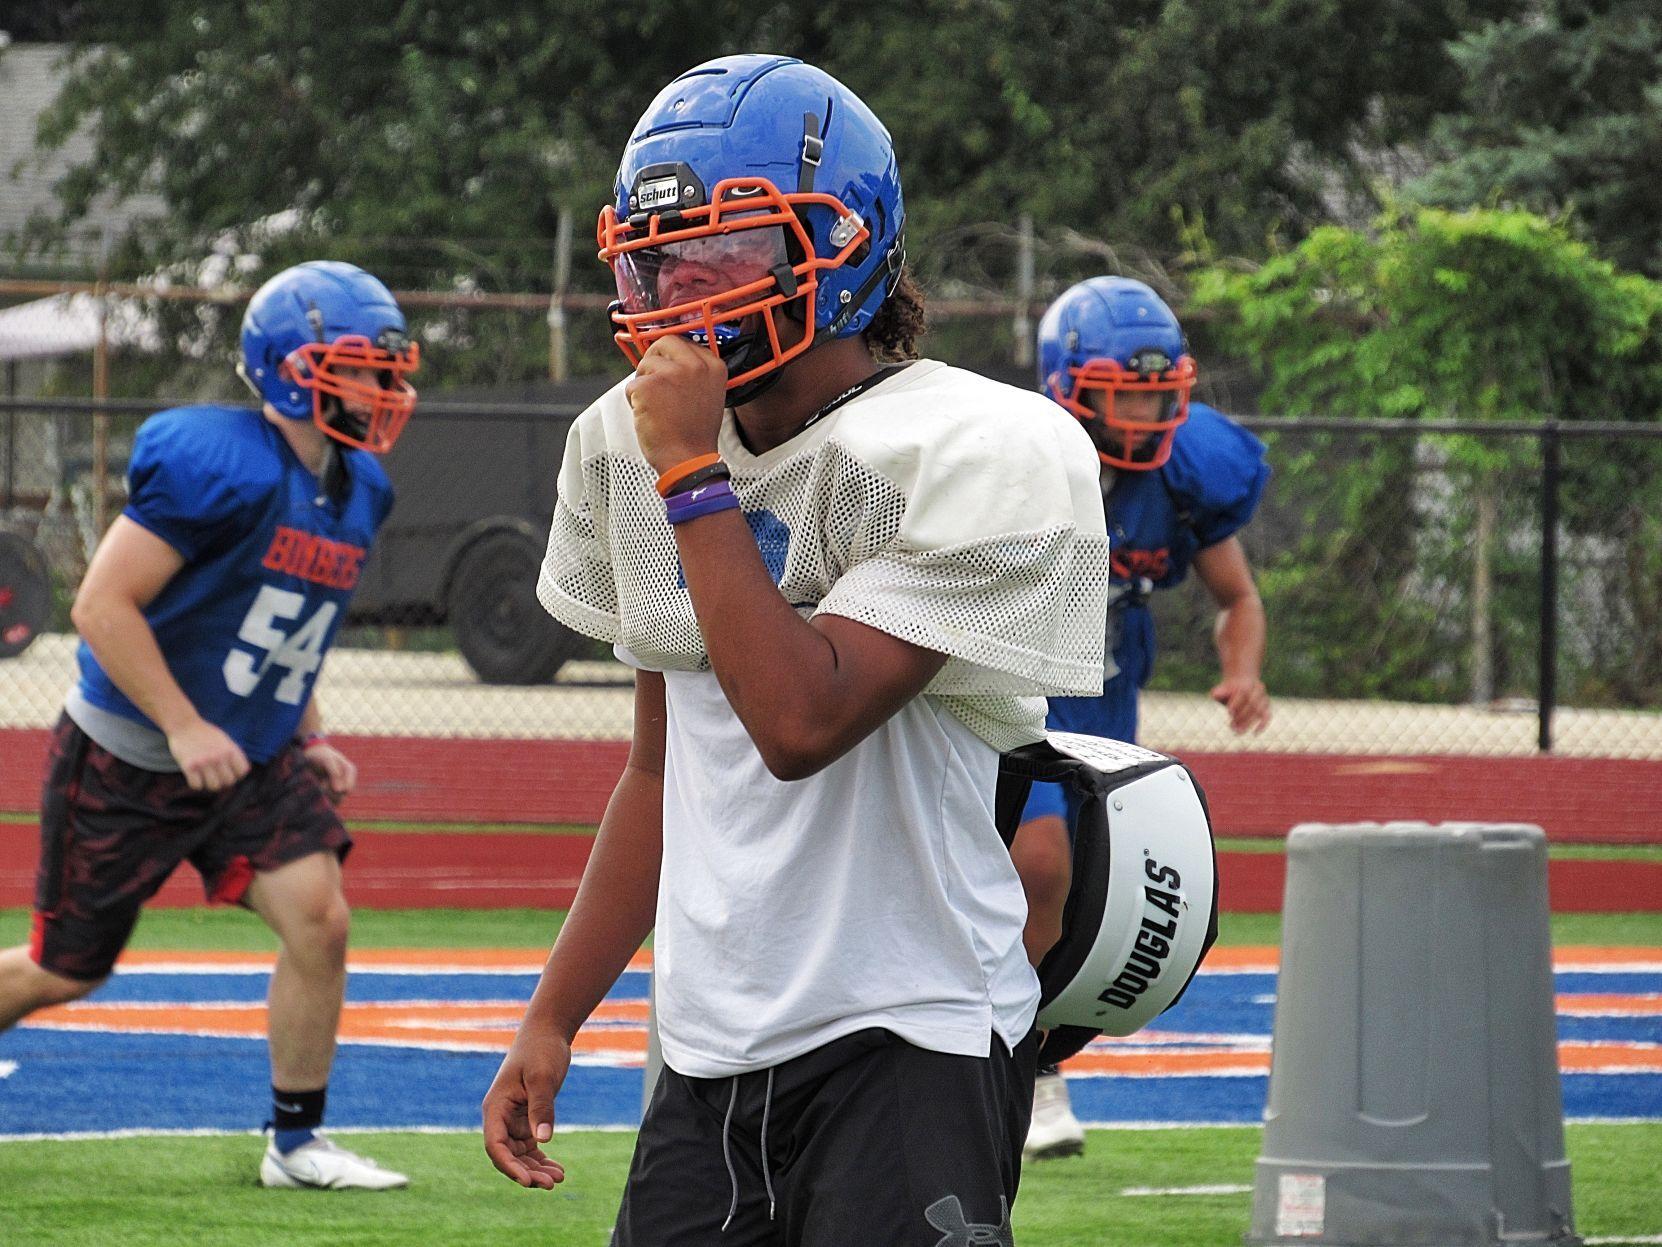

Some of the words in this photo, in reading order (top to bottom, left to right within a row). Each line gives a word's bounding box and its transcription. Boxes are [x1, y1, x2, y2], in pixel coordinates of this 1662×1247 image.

[640, 186, 677, 203] schutt
[222, 584, 338, 706] 54
[1097, 858, 1181, 1010] DOUGLAS
